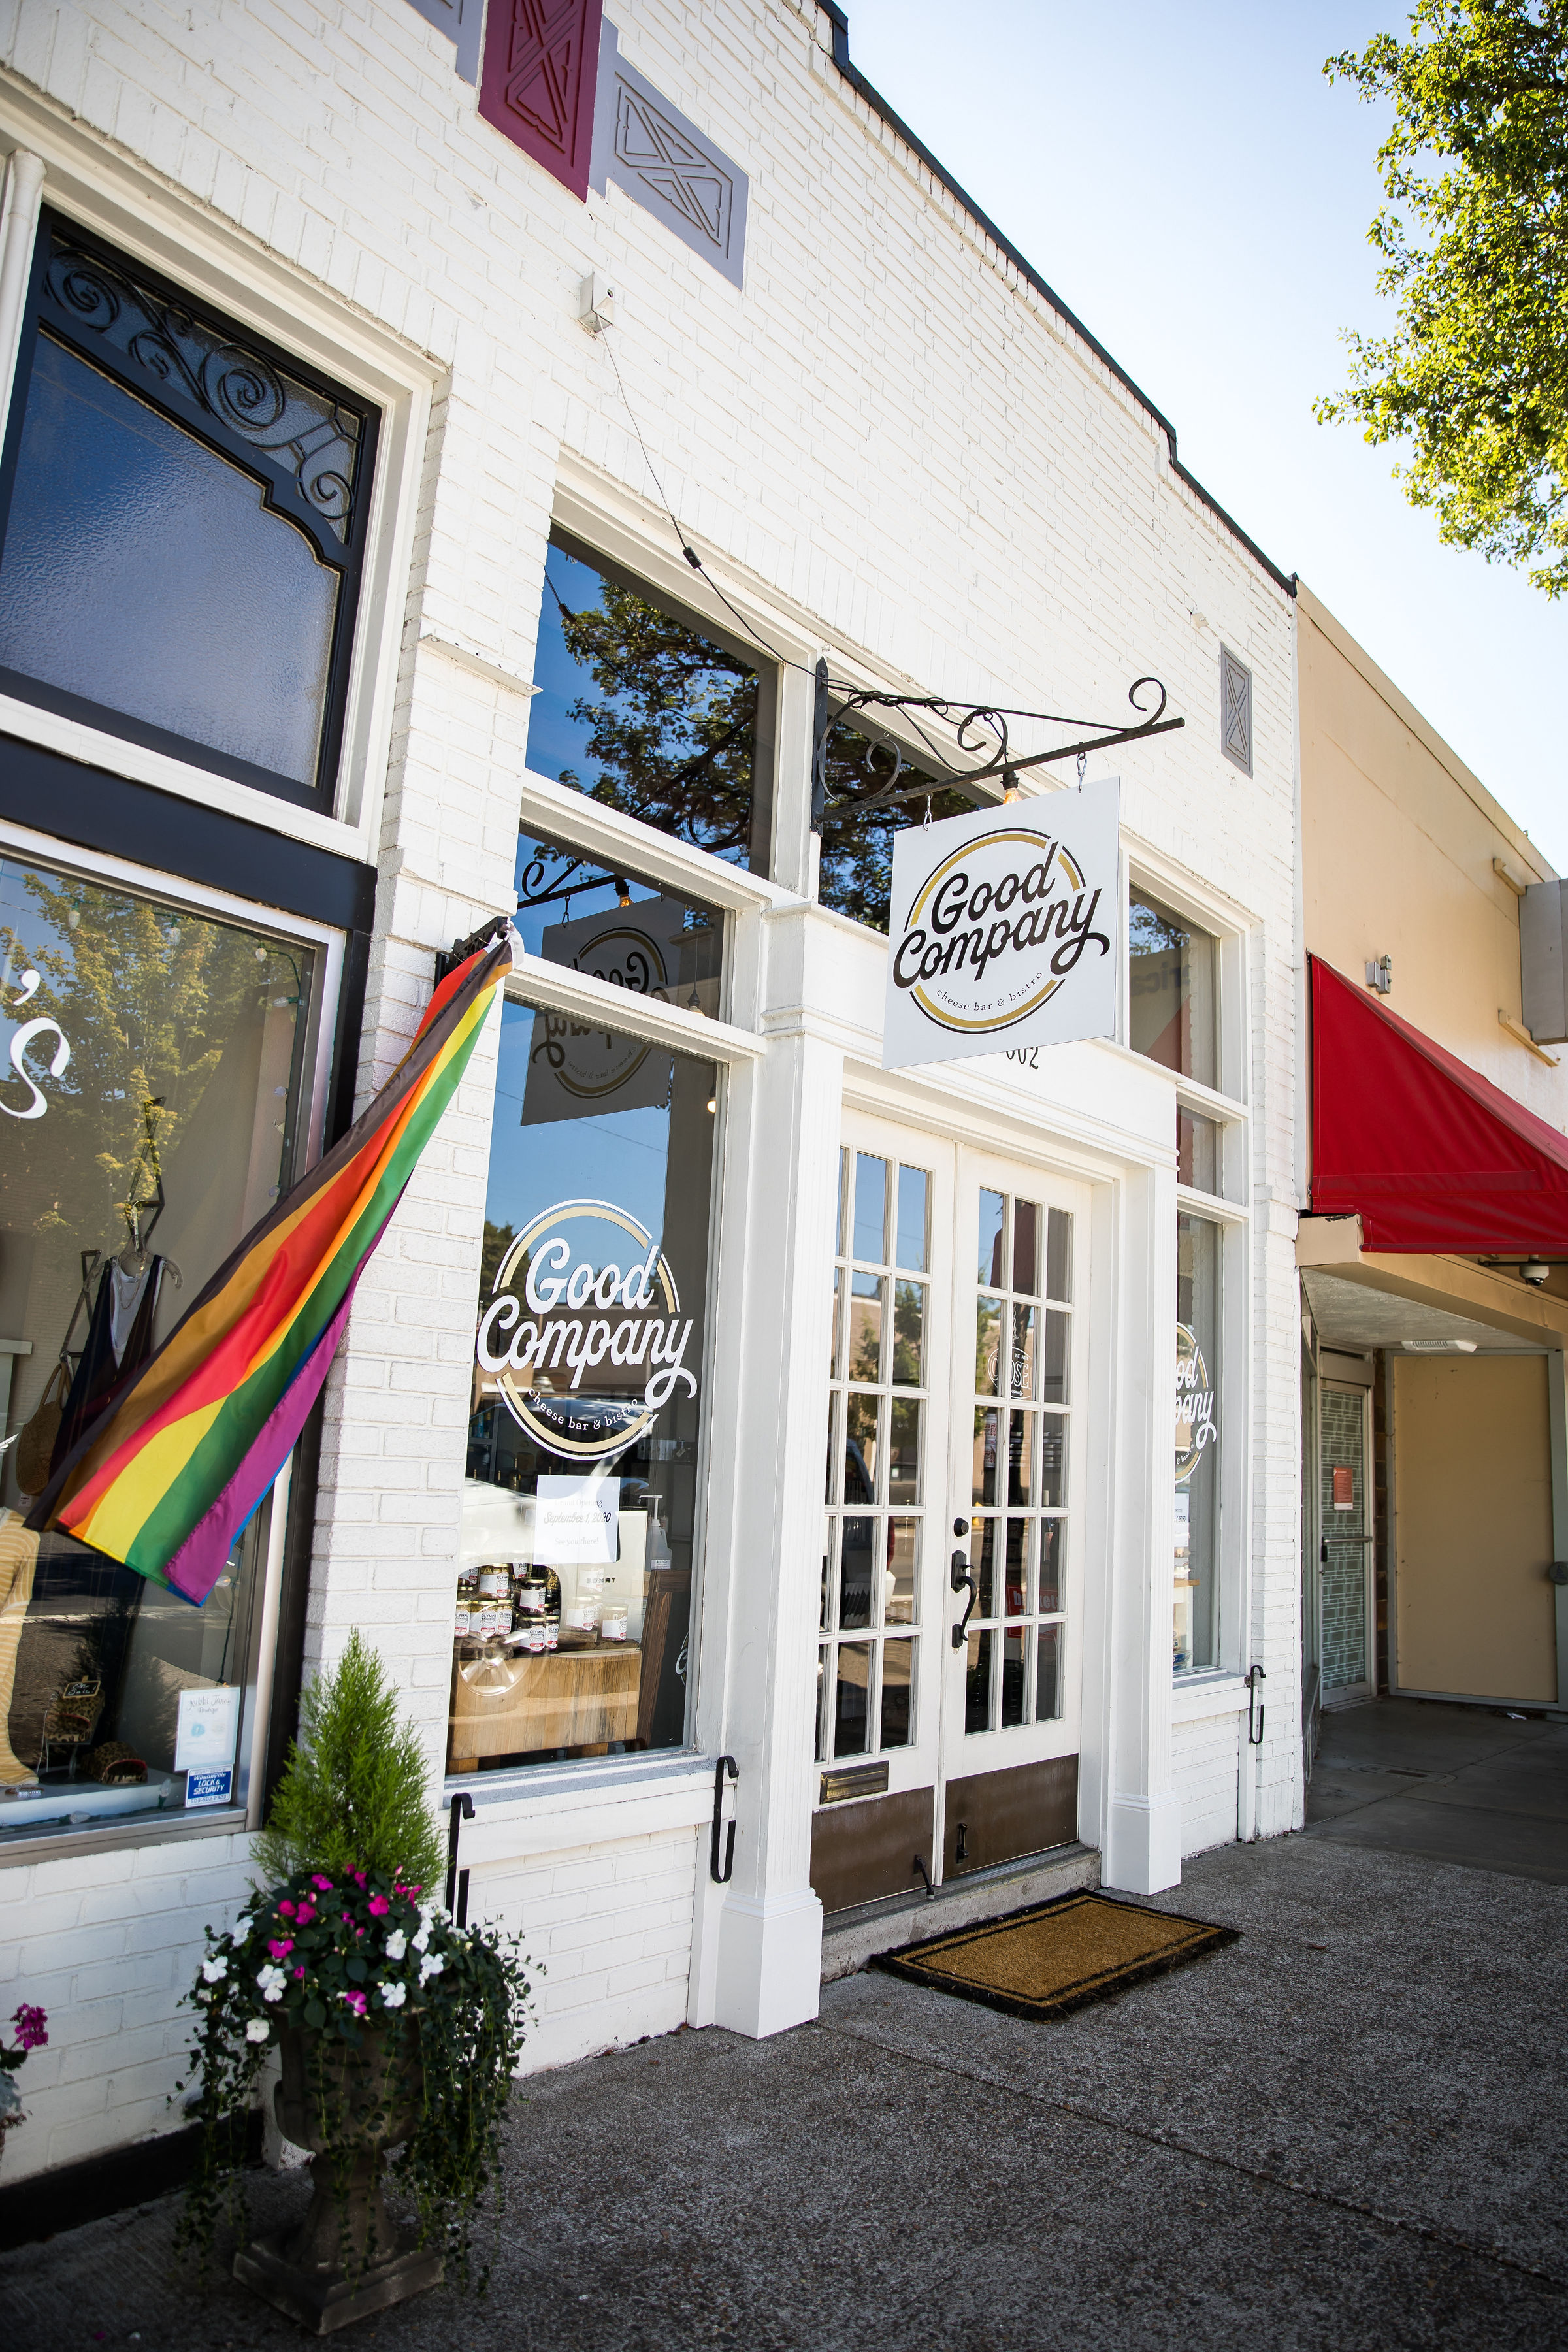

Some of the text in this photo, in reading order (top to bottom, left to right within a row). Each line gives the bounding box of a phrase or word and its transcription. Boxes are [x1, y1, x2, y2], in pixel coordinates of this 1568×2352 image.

[931, 841, 1059, 935] Good
[892, 888, 1111, 989] Company
[936, 972, 1043, 1011] cheese bar & bistro
[525, 1237, 660, 1315] Good
[477, 1295, 698, 1409] Company
[1176, 1346, 1199, 1390] od
[528, 1388, 638, 1431] cheese bar & bistro
[544, 1511, 584, 1526] September
[591, 1512, 612, 1523] 2020
[193, 1784, 225, 1795] SECURITY
[194, 1772, 227, 1780] Wilsonville
[198, 1778, 216, 1788] LOCK
